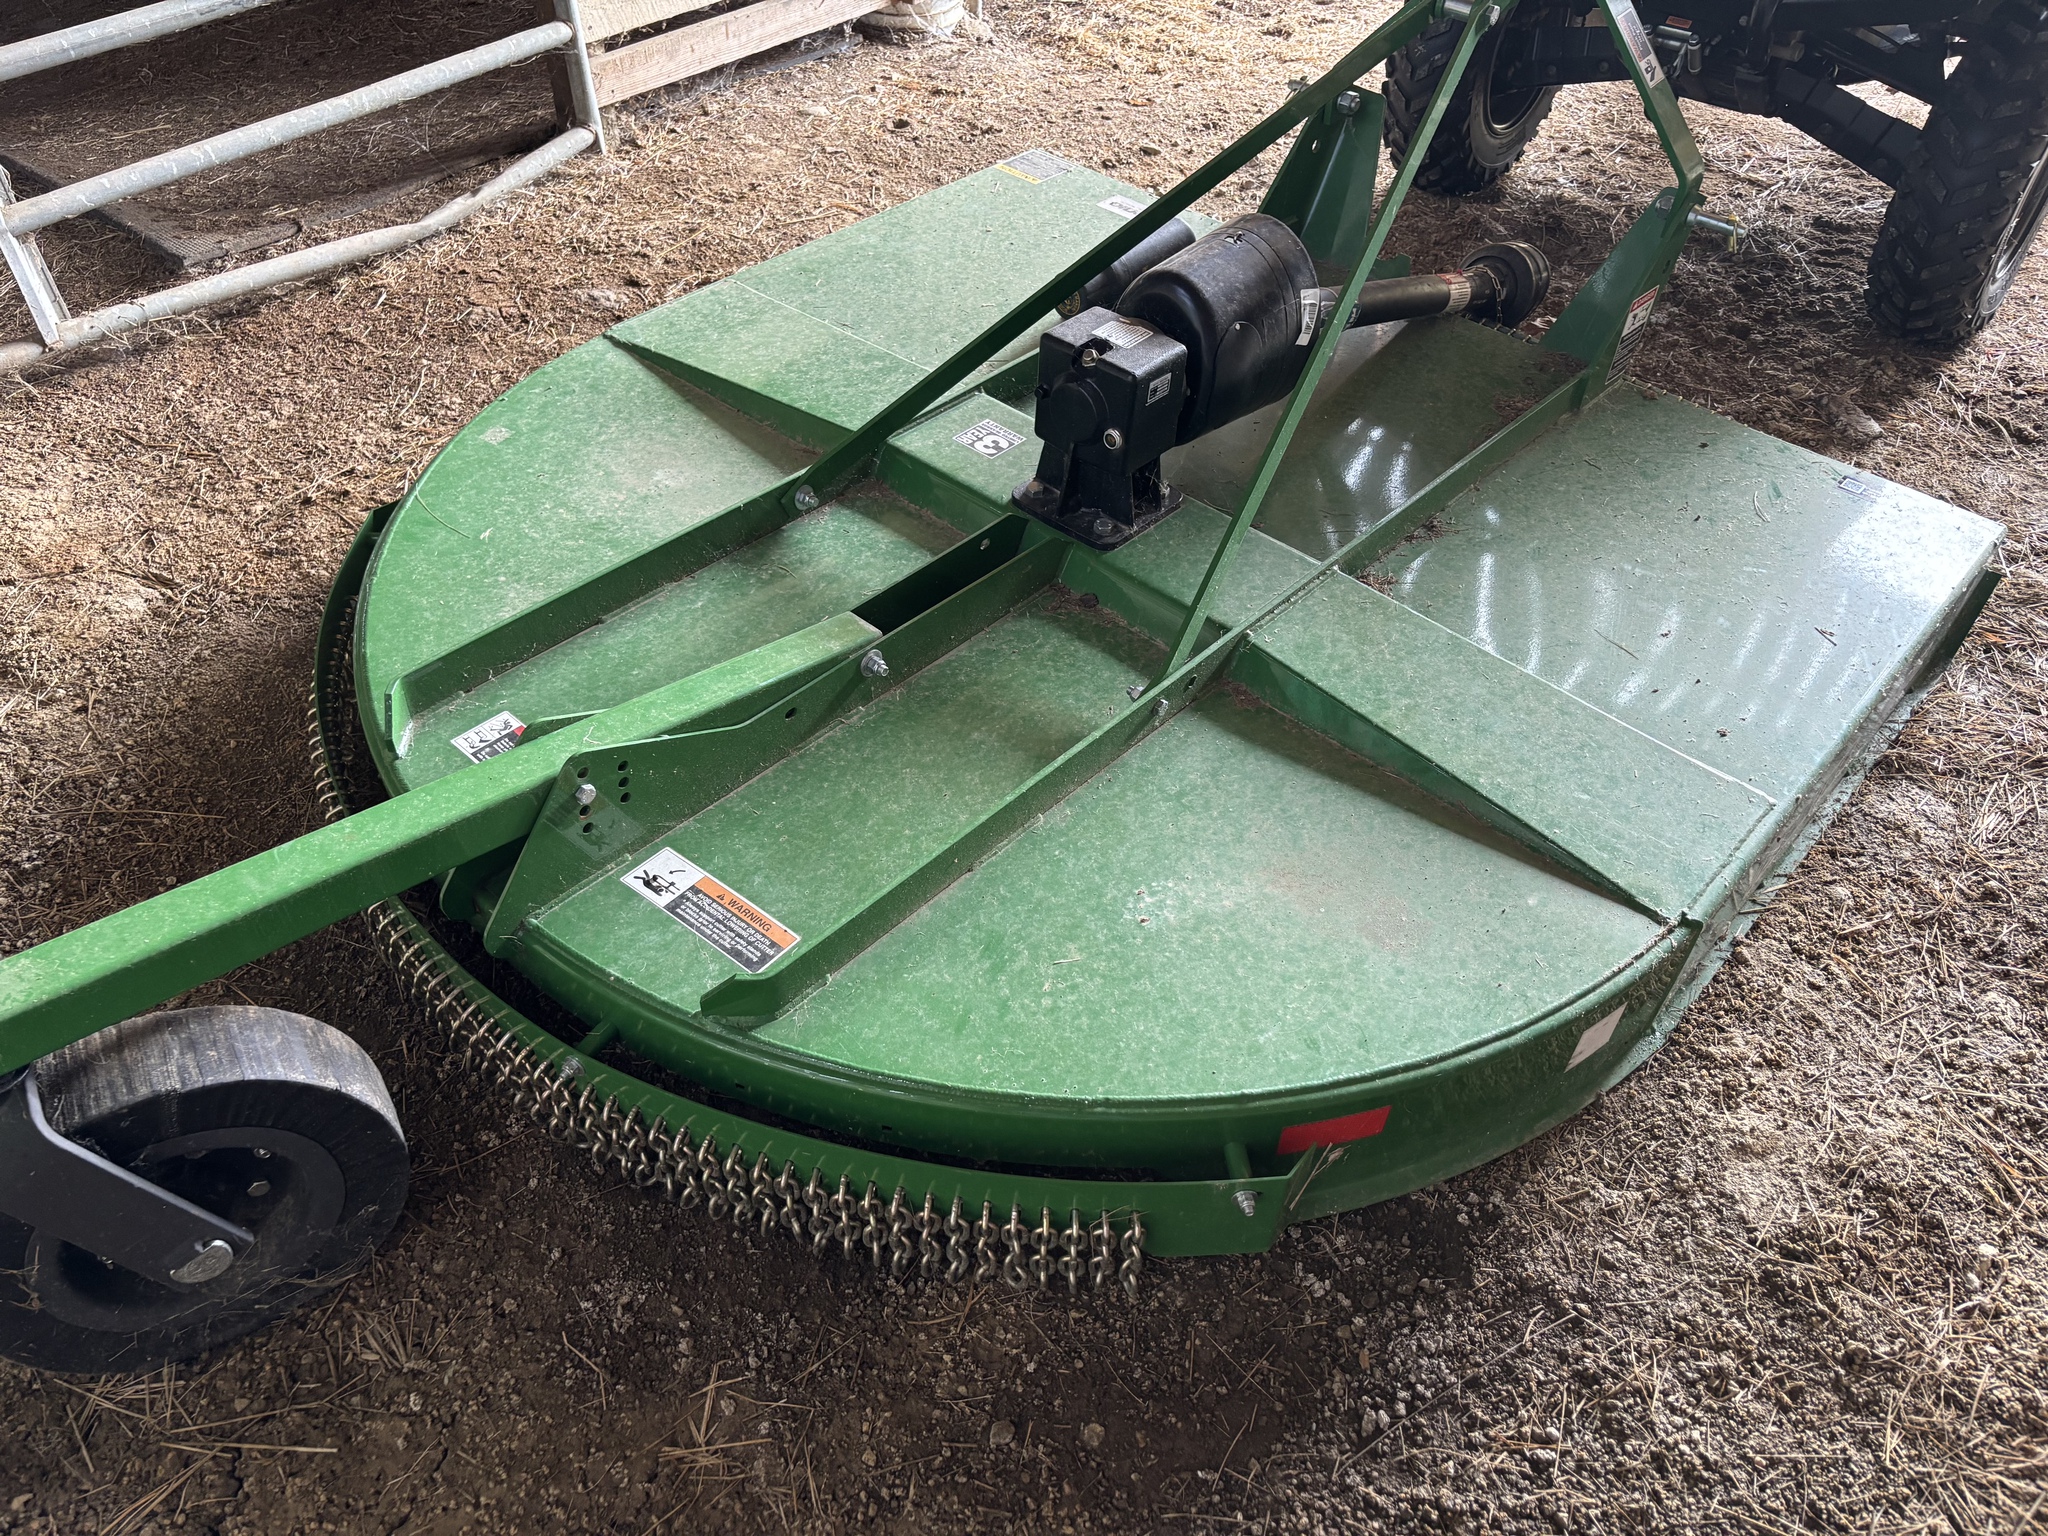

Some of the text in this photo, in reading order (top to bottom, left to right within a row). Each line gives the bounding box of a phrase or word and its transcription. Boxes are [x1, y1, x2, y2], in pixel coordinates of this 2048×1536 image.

[958, 427, 990, 443] YEAR
[984, 420, 1024, 441] WARRANTY
[973, 434, 1010, 455] 3
[696, 892, 712, 904] AVOID
[709, 902, 732, 918] SERIOUS
[729, 915, 748, 929] INJURY
[752, 932, 771, 945] DEATH
[727, 898, 772, 932] WARNING
[723, 918, 749, 937] LOWERING
[746, 935, 757, 943] OF
[753, 940, 774, 955] CUTTER
